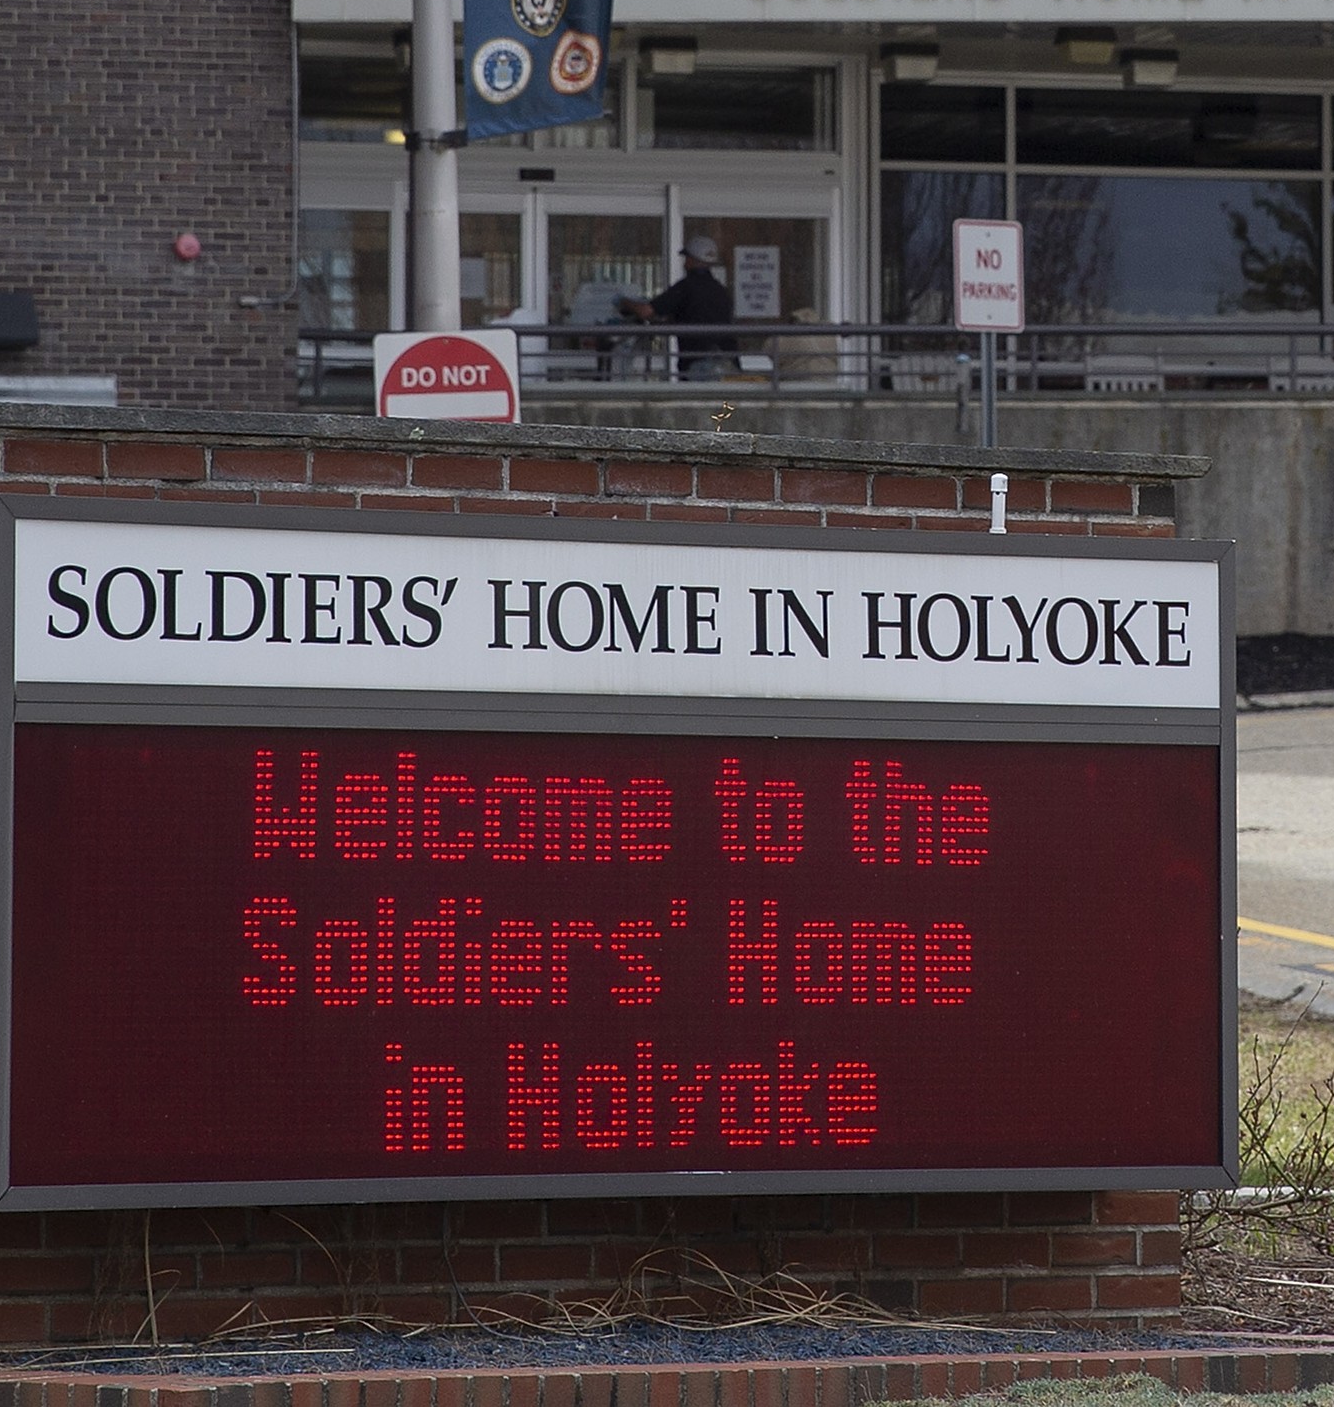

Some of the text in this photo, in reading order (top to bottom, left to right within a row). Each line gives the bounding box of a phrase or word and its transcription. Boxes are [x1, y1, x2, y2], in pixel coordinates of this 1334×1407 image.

[962, 281, 1017, 302] PARKING
[975, 248, 1003, 270] NO
[400, 364, 491, 388] DO NOT
[47, 565, 1192, 667] SOLDIERS' HOME IN HOLYOKE
[254, 750, 989, 866] Welcome to the
[243, 897, 972, 1006] Soldiers' Home
[384, 1041, 878, 1152] in Holyoke
